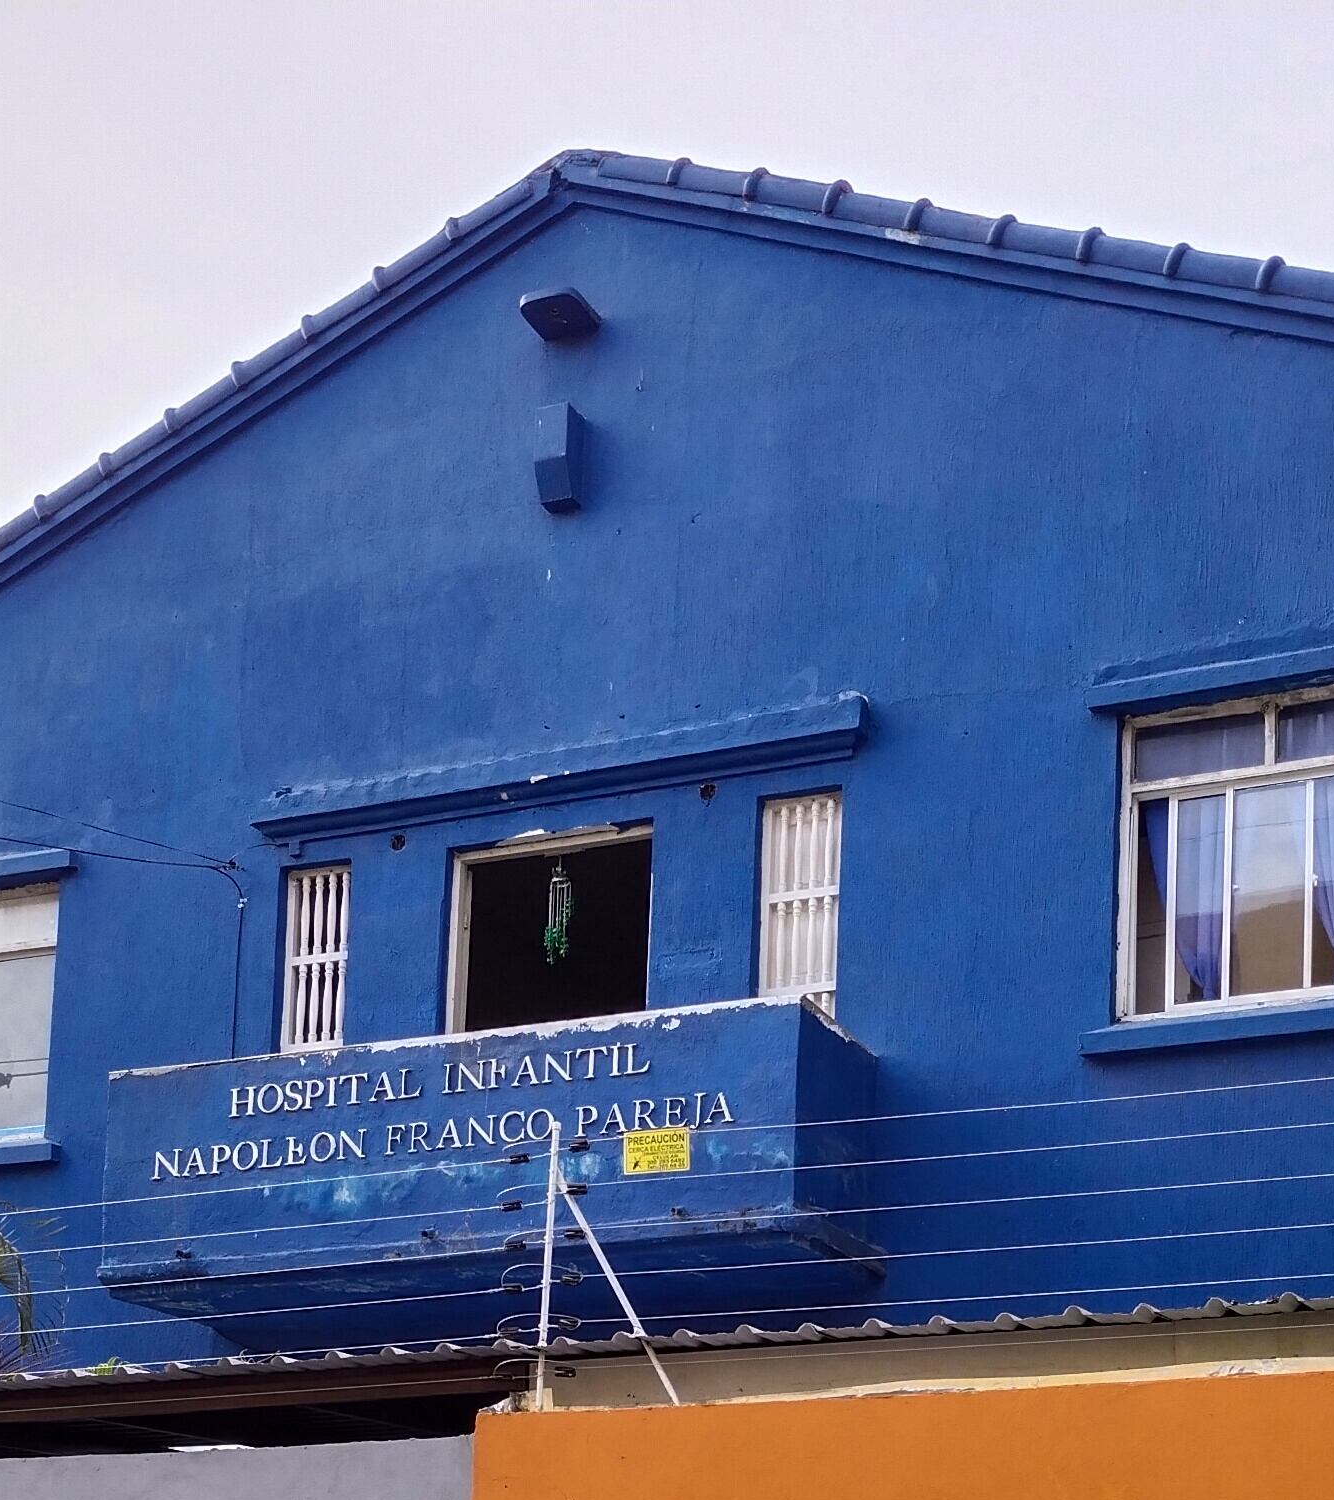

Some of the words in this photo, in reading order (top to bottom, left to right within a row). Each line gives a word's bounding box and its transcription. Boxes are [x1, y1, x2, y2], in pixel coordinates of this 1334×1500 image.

[229, 1068, 423, 1118] HOSPITAL
[442, 1042, 651, 1095] INFANTIL
[150, 1128, 367, 1181] NAPOLEON
[385, 1108, 554, 1156] FRANCO
[575, 1092, 734, 1137] PAREJA
[628, 1131, 685, 1146] PRECAUCIÓN
